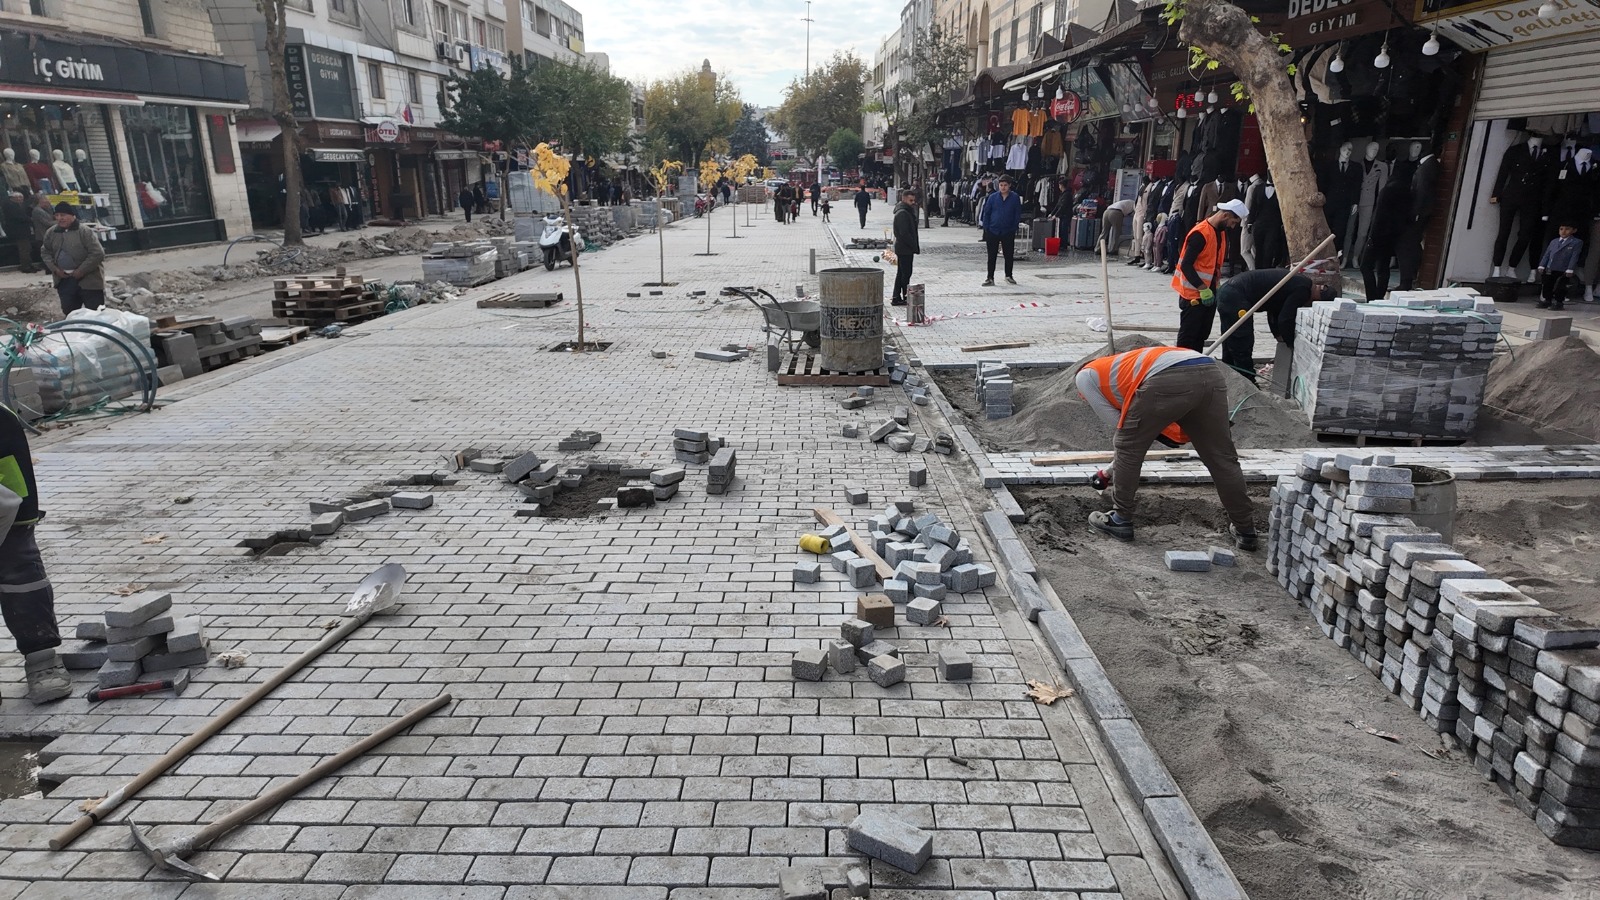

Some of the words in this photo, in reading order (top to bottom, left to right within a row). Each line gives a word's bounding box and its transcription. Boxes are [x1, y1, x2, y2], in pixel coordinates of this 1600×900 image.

[1288, 0, 1352, 19] DED
[311, 52, 343, 68] DEDECAN
[288, 47, 306, 108] DEDECAN
[378, 128, 397, 136] OTEL
